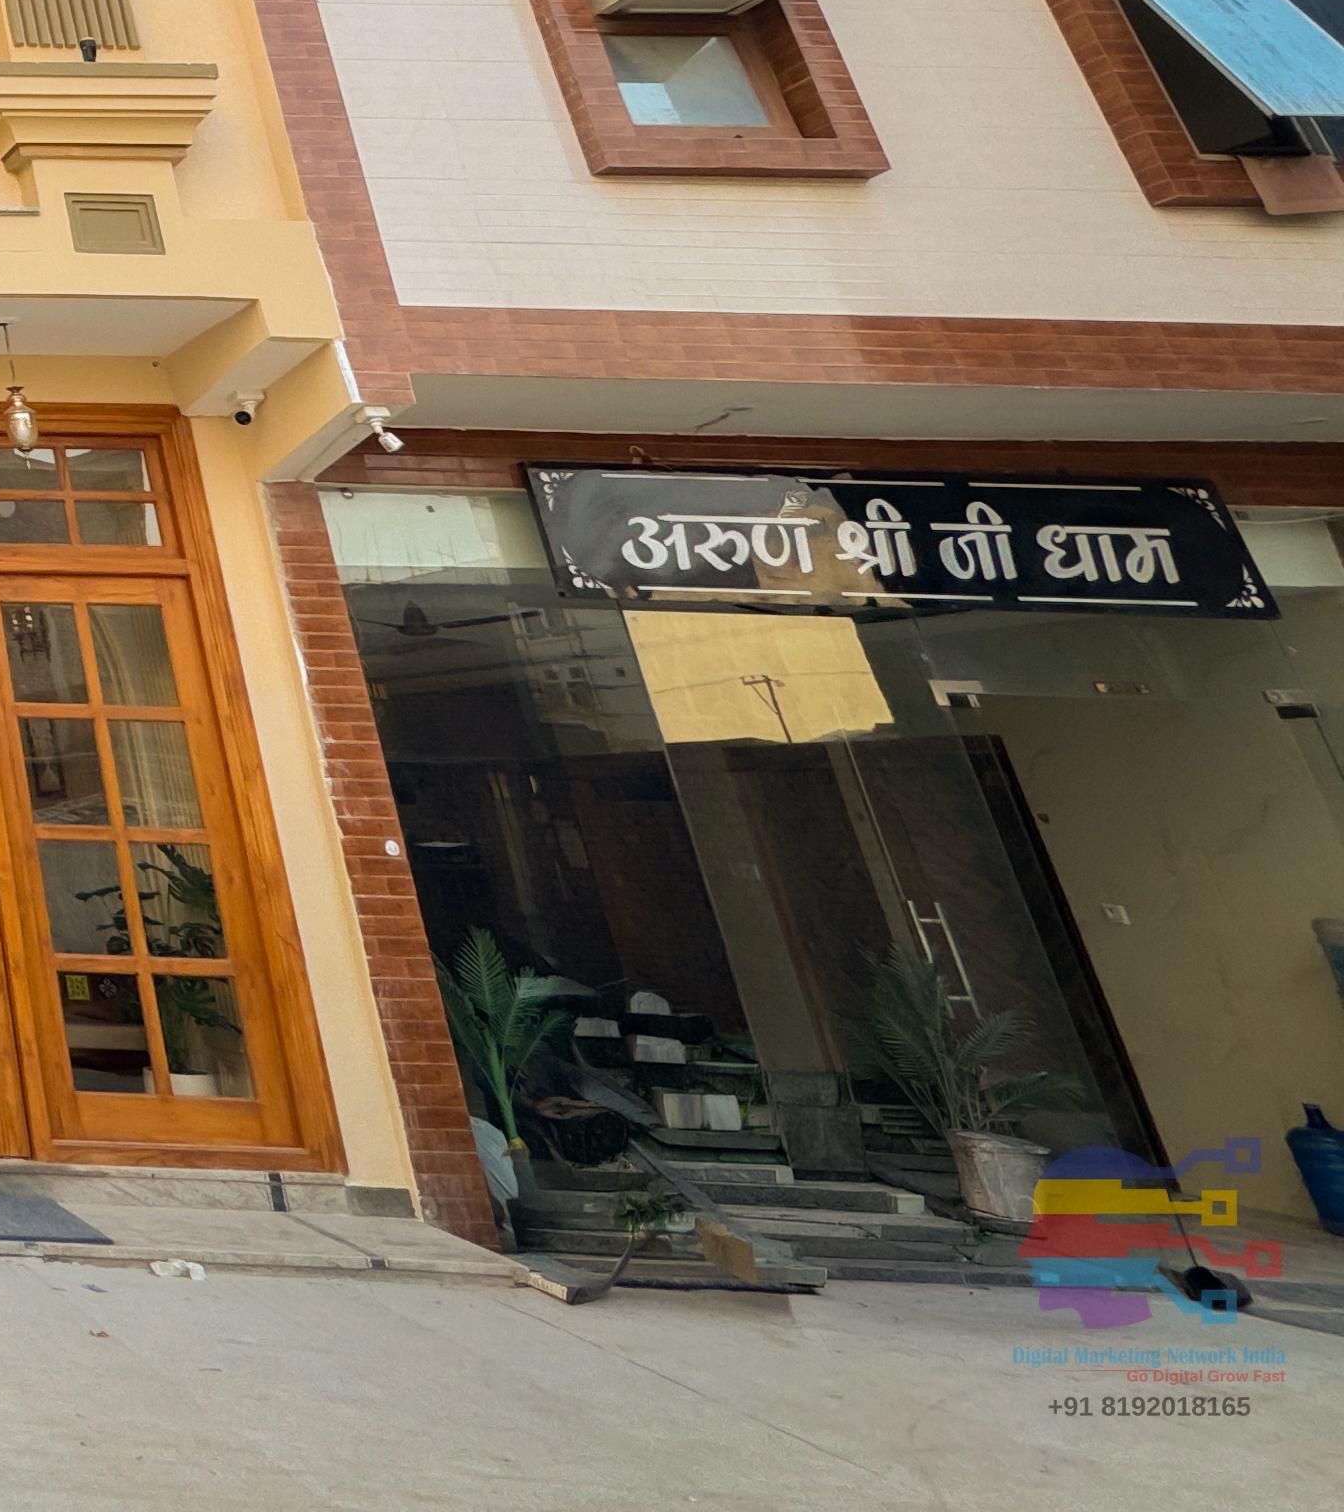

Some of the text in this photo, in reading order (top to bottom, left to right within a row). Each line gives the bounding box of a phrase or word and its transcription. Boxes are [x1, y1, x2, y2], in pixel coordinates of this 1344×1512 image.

[621, 498, 1181, 584] अरुण श्री जी धाम
